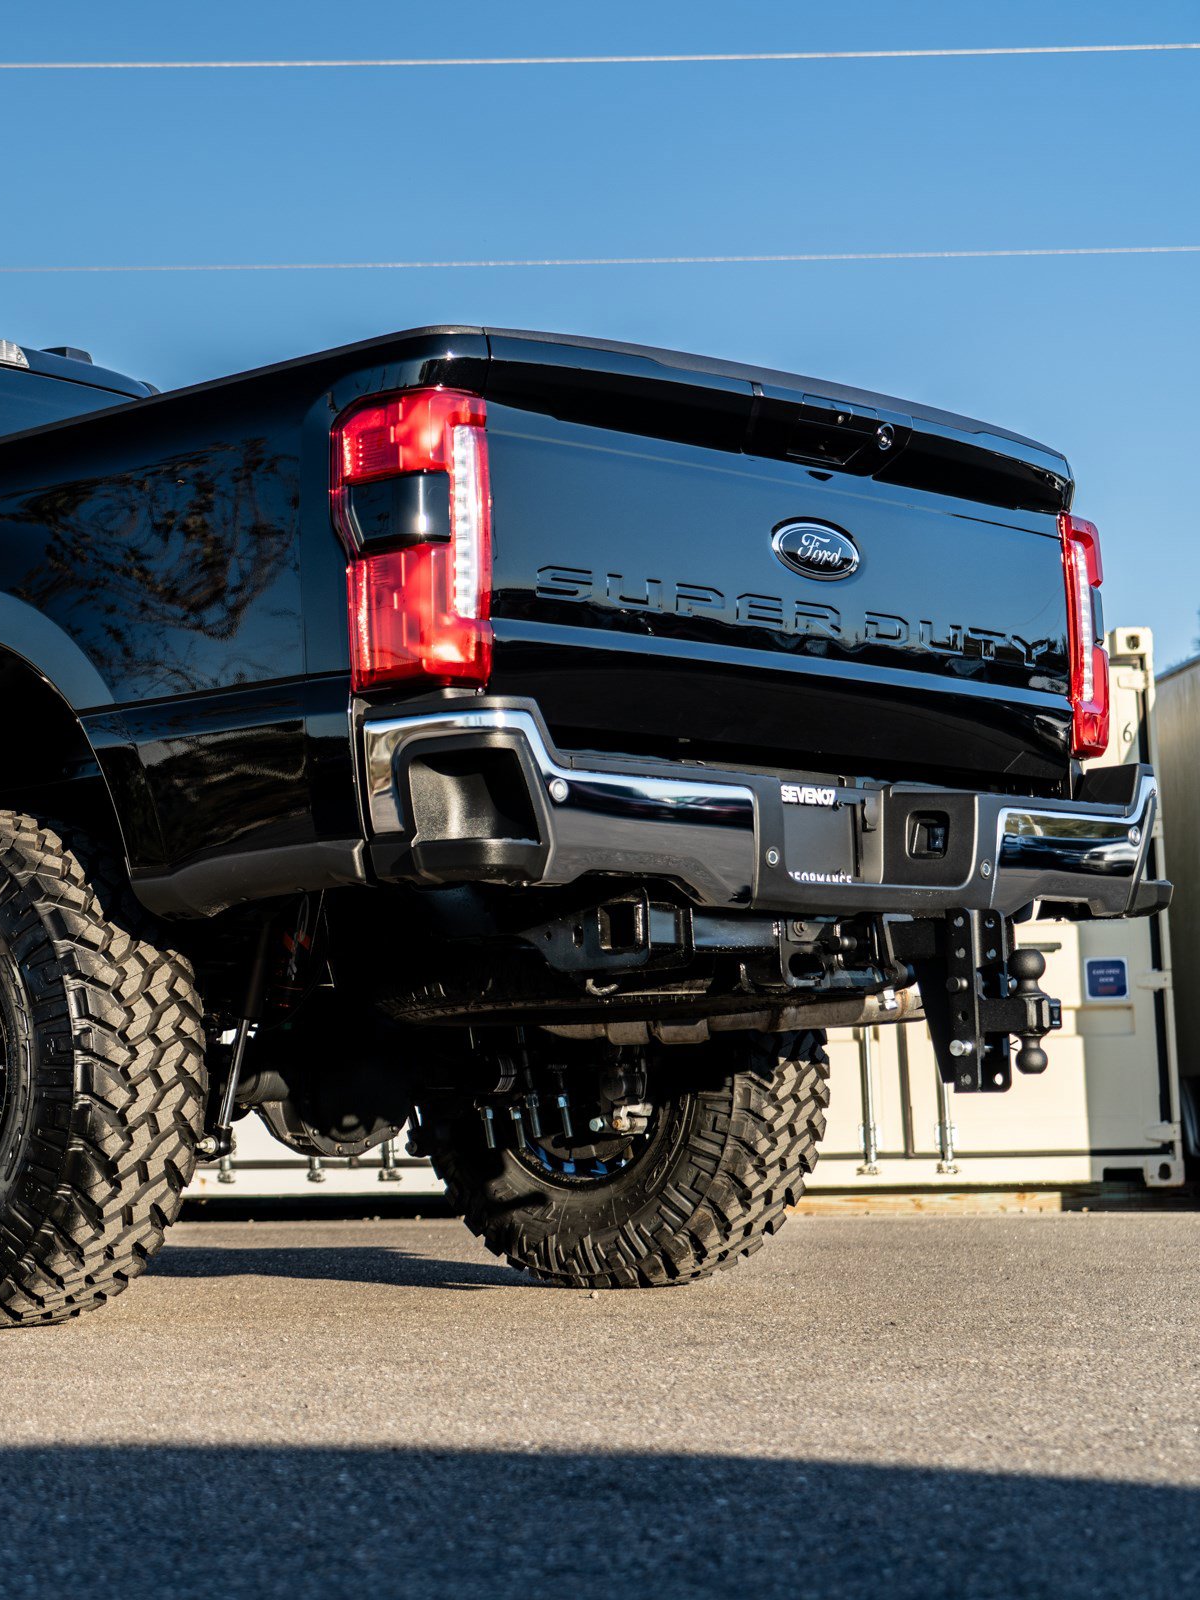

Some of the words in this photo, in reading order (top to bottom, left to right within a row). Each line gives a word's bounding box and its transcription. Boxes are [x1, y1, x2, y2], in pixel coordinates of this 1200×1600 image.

[798, 533, 842, 568] Ford
[536, 565, 842, 635] SUPER
[865, 611, 1049, 668] DUTY
[1122, 721, 1133, 743] 6
